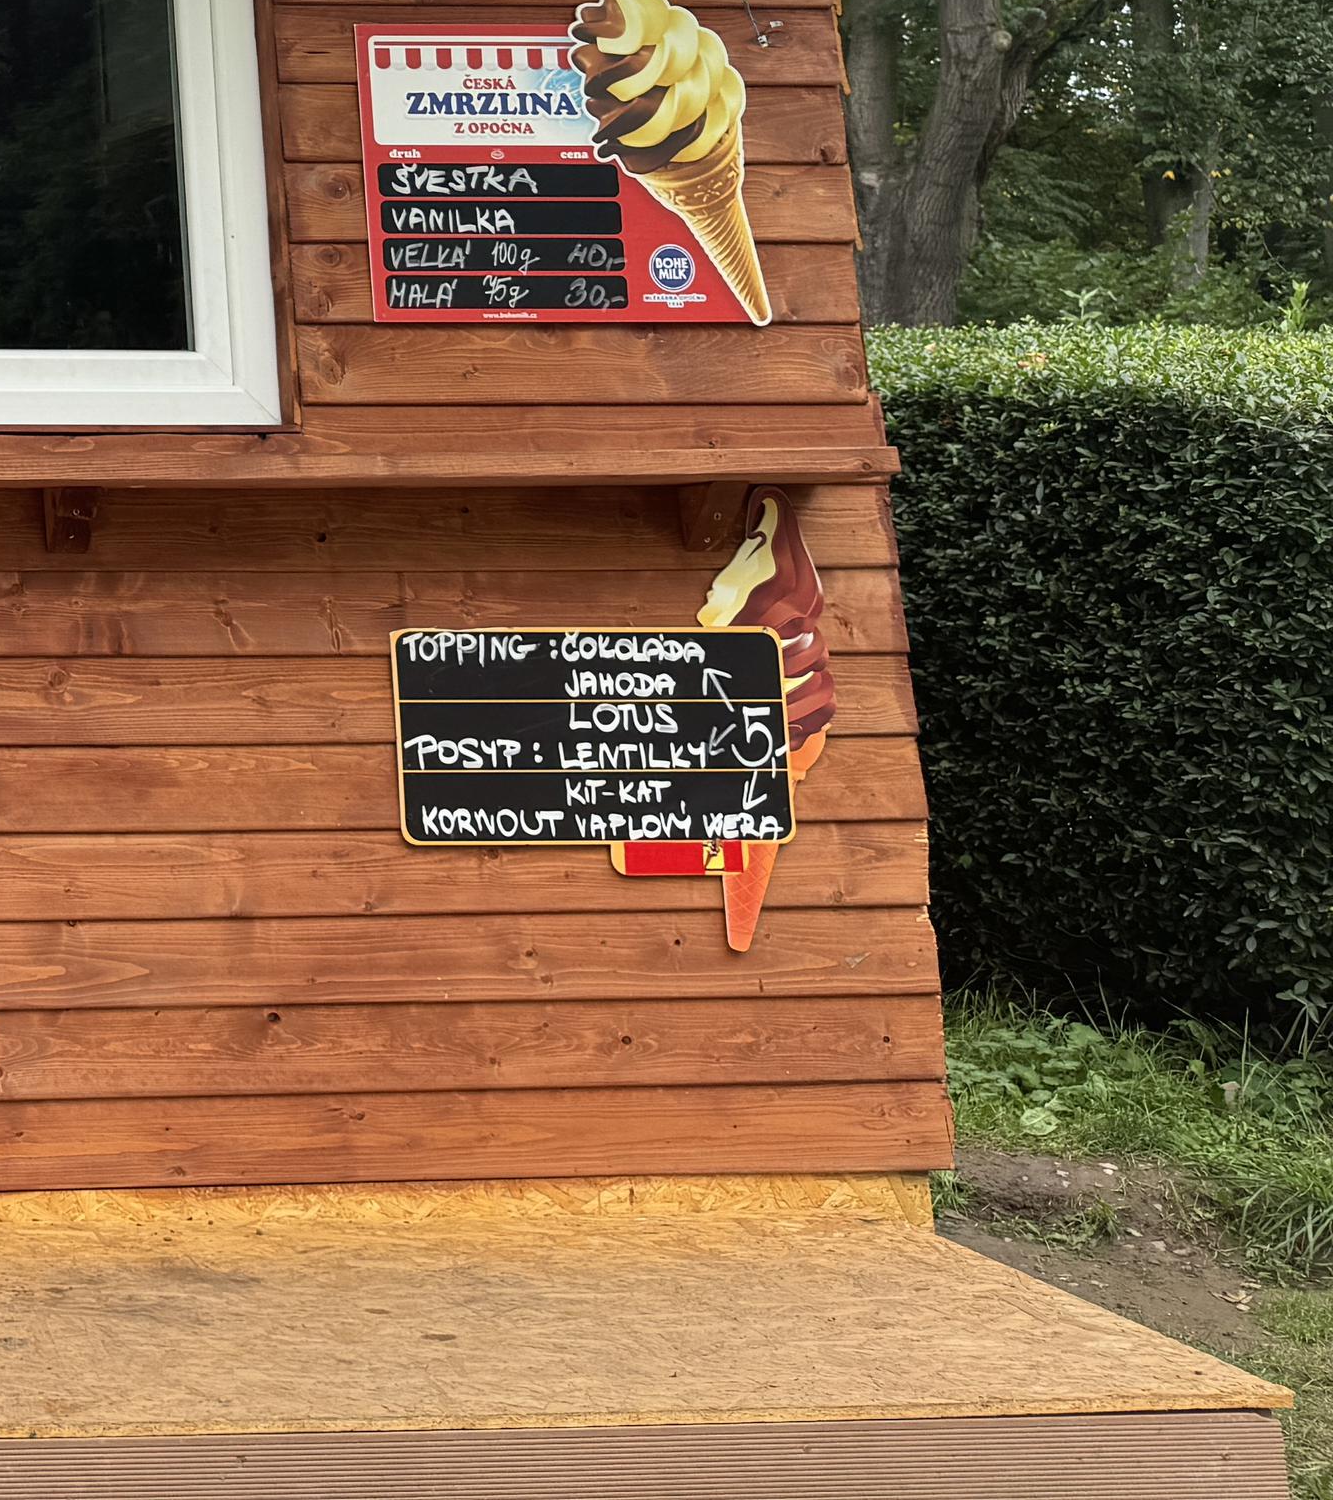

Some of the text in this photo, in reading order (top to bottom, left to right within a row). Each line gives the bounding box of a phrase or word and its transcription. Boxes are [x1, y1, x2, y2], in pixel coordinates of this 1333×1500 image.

[463, 74, 516, 90] ČESKÁ
[406, 92, 579, 116] ZMRZLINA
[454, 119, 535, 134] Z OPOČNA
[389, 149, 589, 159] druh cena
[391, 162, 538, 194] ŠVESTKA
[391, 207, 515, 234] VANILKA
[390, 239, 471, 269] VELKÁ
[655, 257, 689, 269] BOHE
[659, 269, 687, 280] MILK
[389, 278, 458, 309] MALÁ
[402, 632, 537, 667] TOPPING
[561, 631, 705, 663] ČOKOLÁDA
[564, 669, 676, 697] JAHODA
[568, 703, 678, 734] LOTUS
[403, 735, 521, 770] POSYP
[558, 742, 707, 770] LENTILKY
[421, 805, 565, 838] KORNOUT
